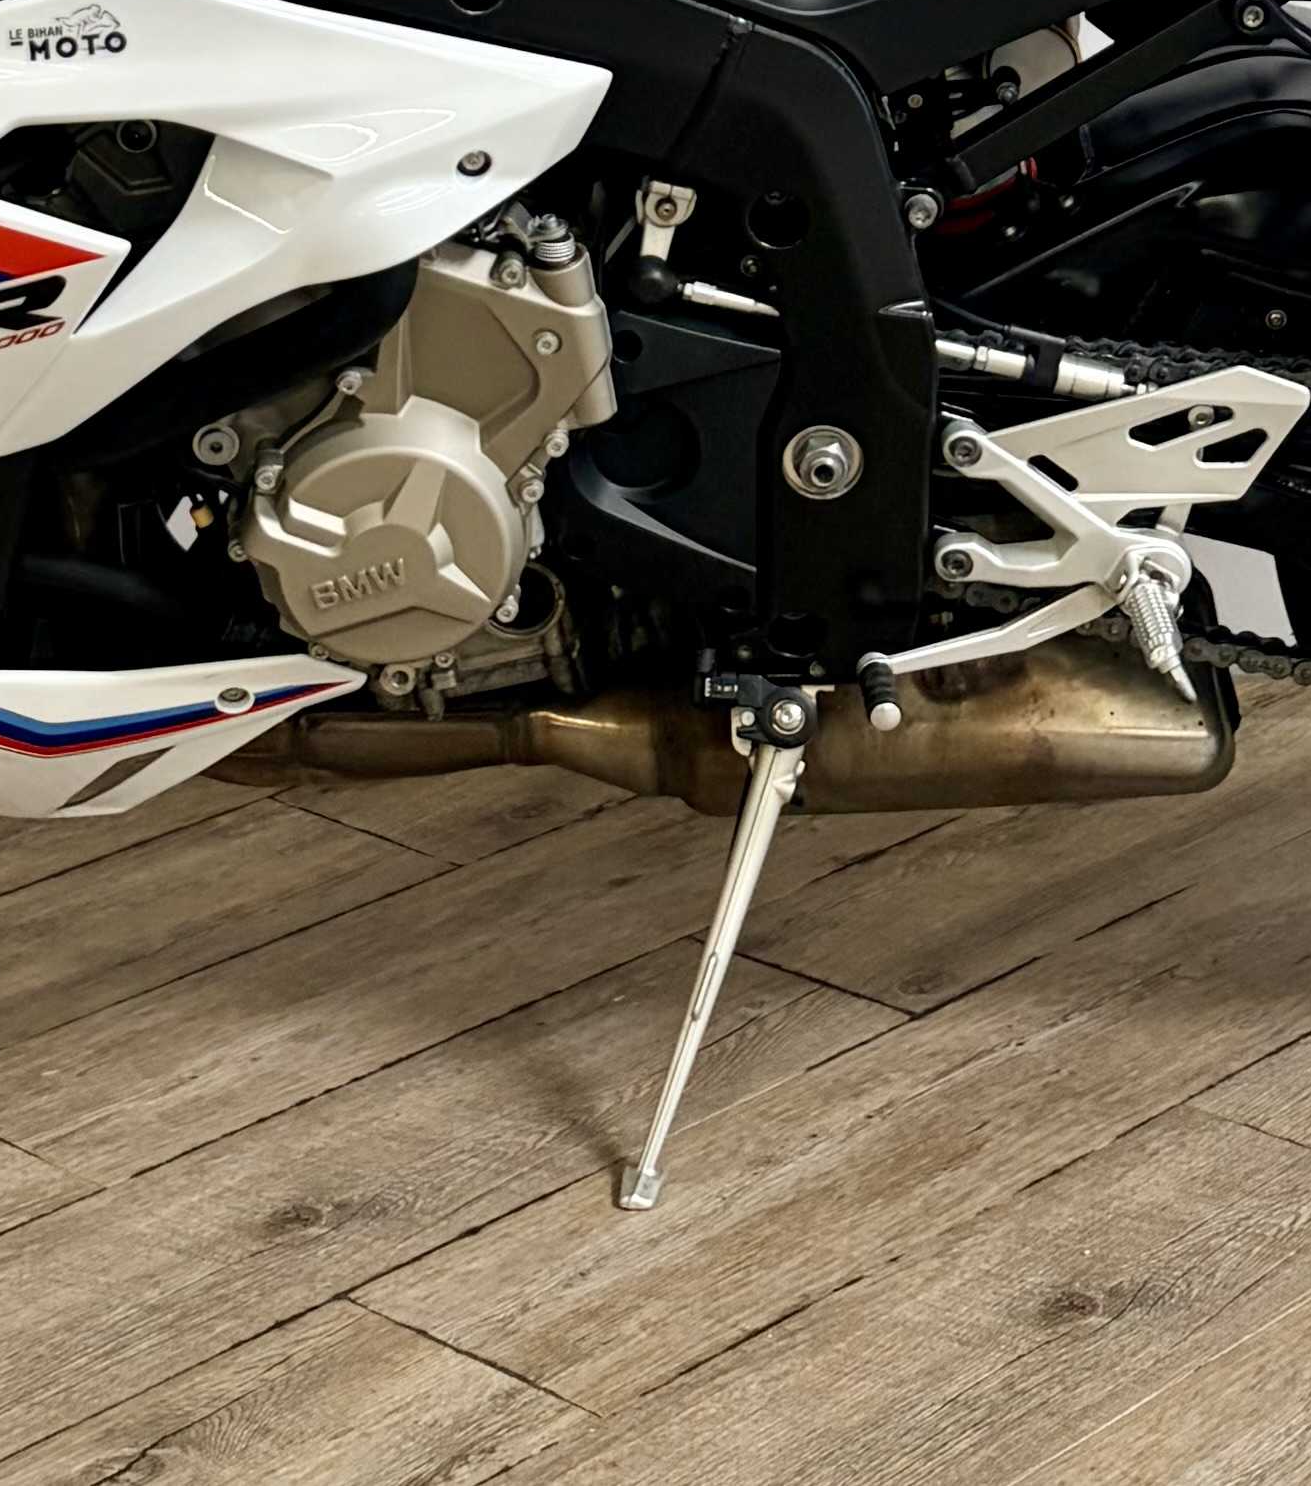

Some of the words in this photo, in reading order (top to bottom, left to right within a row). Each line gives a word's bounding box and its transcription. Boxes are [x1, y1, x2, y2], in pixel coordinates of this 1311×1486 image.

[8, 28, 23, 40] LE
[28, 30, 128, 61] MOTO
[310, 557, 405, 610] BMW
